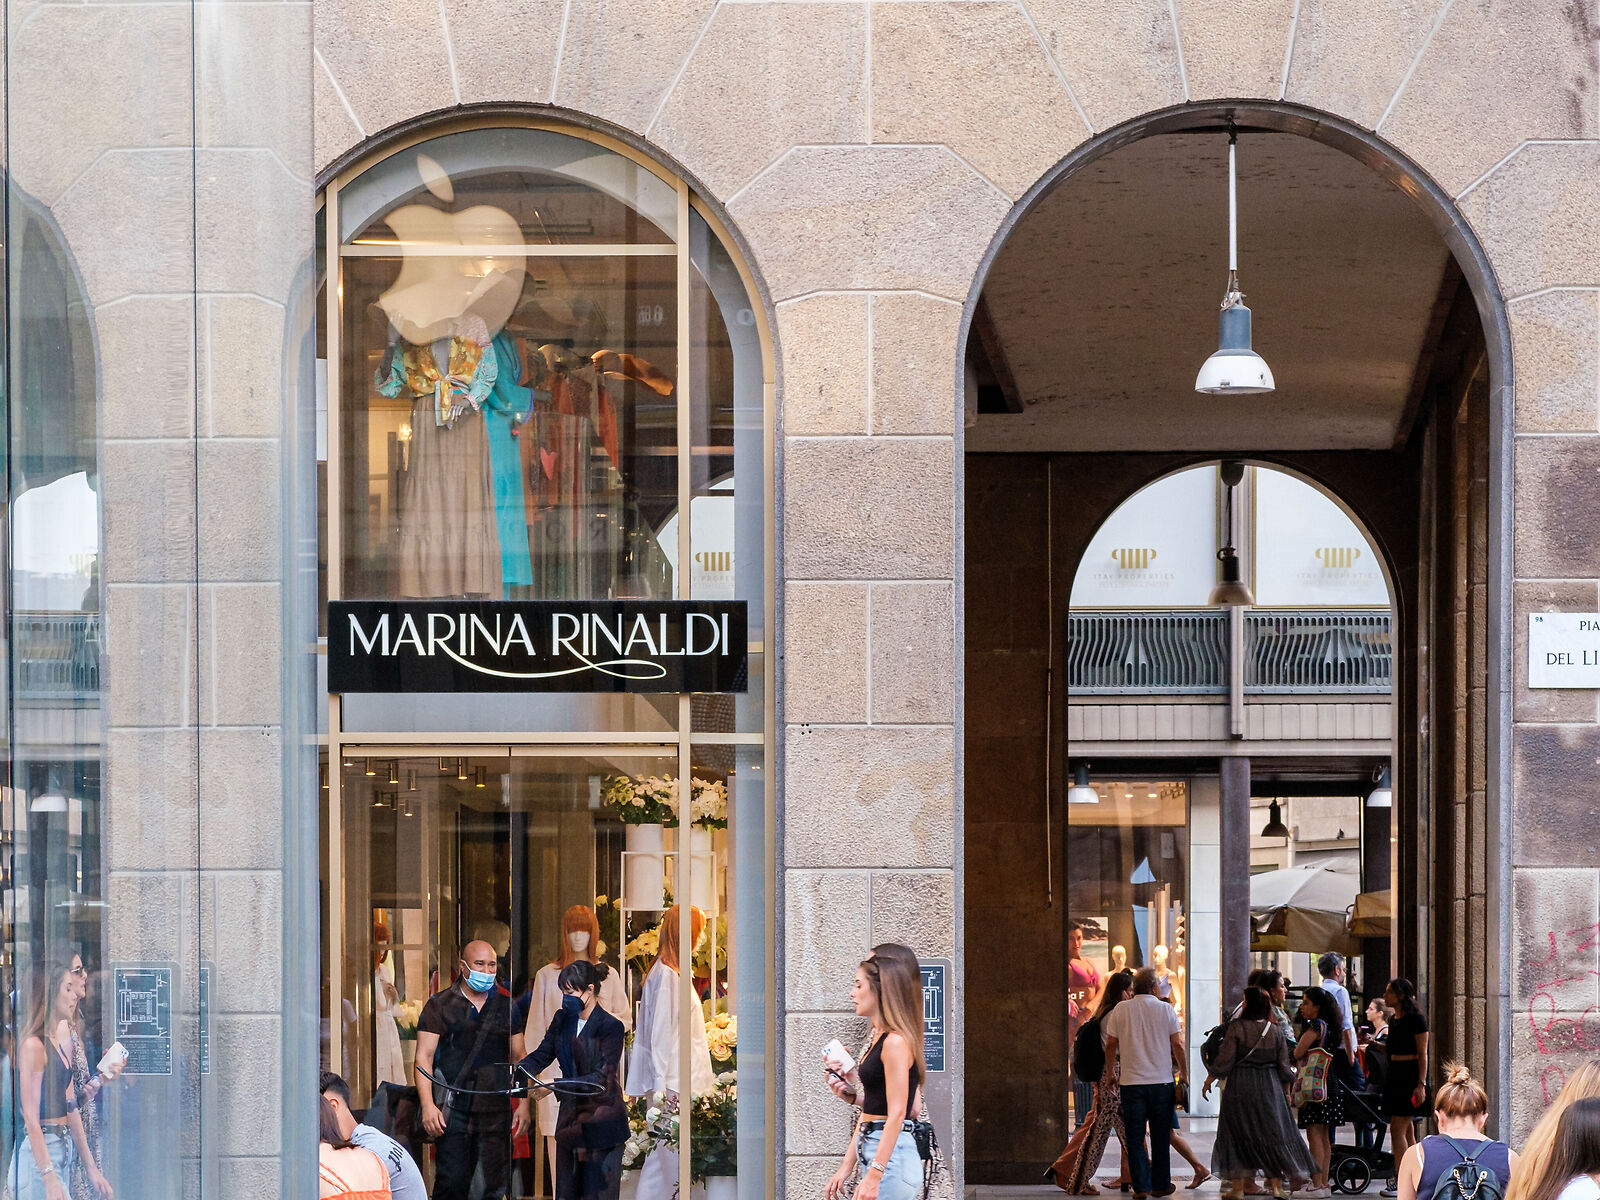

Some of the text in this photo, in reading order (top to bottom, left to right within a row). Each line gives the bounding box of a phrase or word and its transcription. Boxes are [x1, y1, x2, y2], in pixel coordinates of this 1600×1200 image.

[347, 613, 729, 658] MARINA RINALDI
[1546, 652, 1574, 665] DEL
